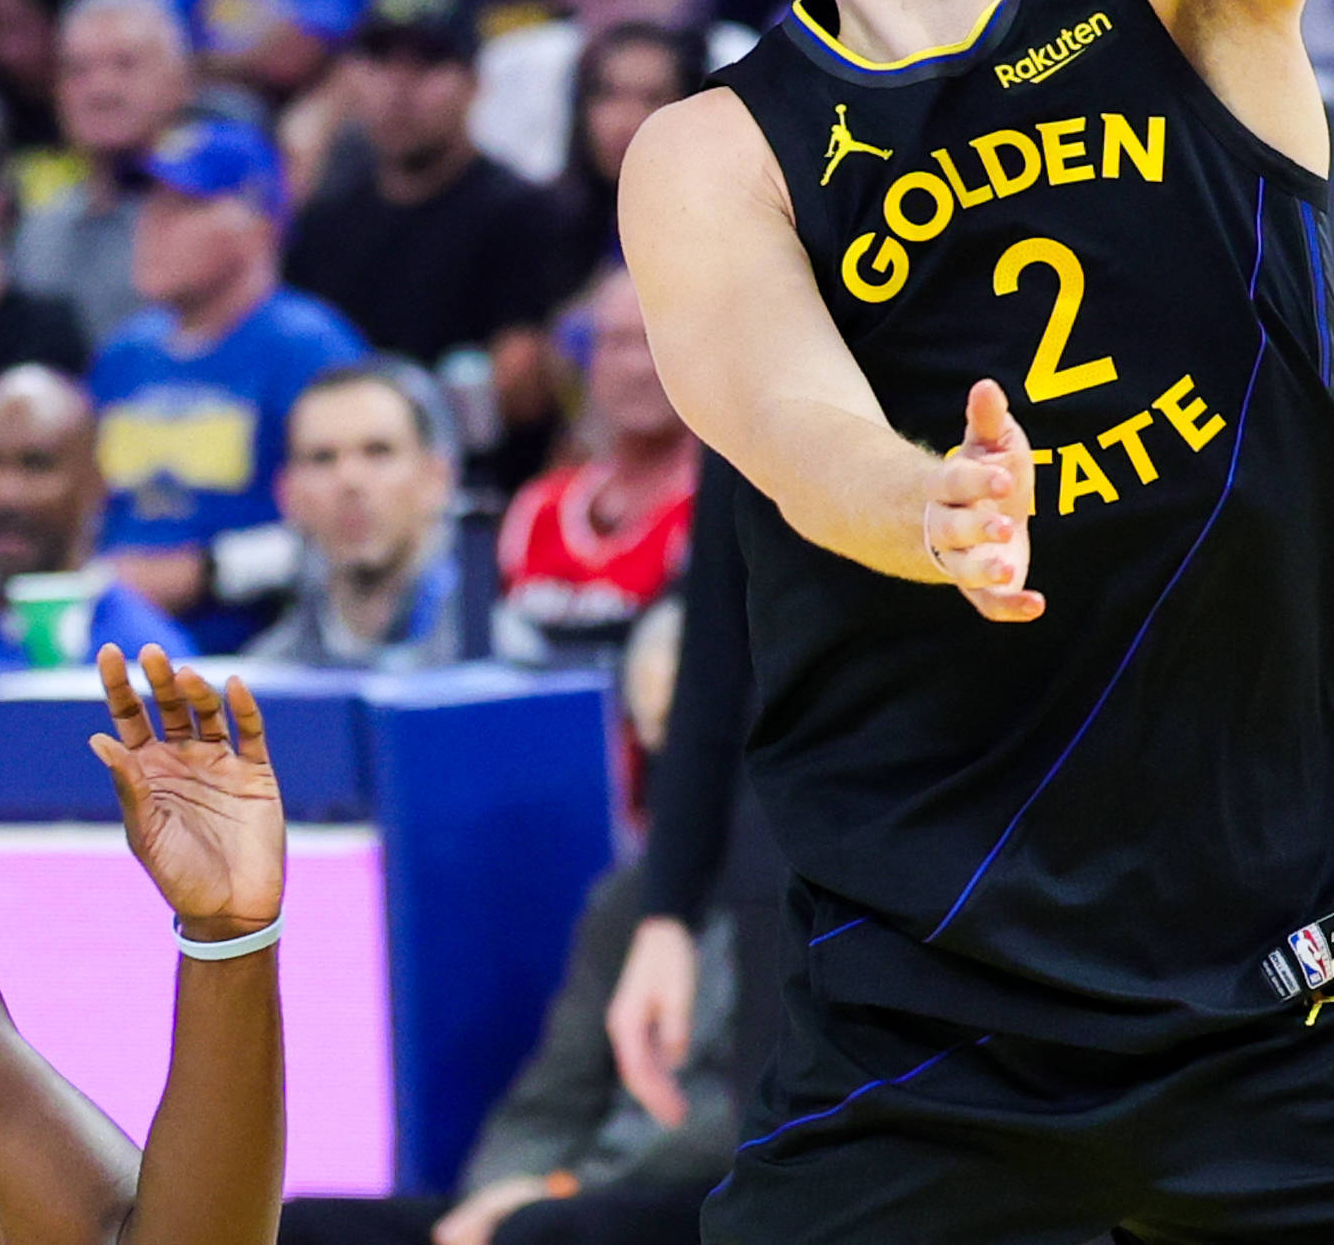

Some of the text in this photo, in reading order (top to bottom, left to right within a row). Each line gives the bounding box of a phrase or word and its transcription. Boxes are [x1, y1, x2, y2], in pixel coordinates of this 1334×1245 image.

[995, 10, 1113, 89] Rakuten
[841, 112, 1166, 303] GOLDEN
[992, 237, 1119, 404] 2
[943, 374, 1227, 516] ATE
